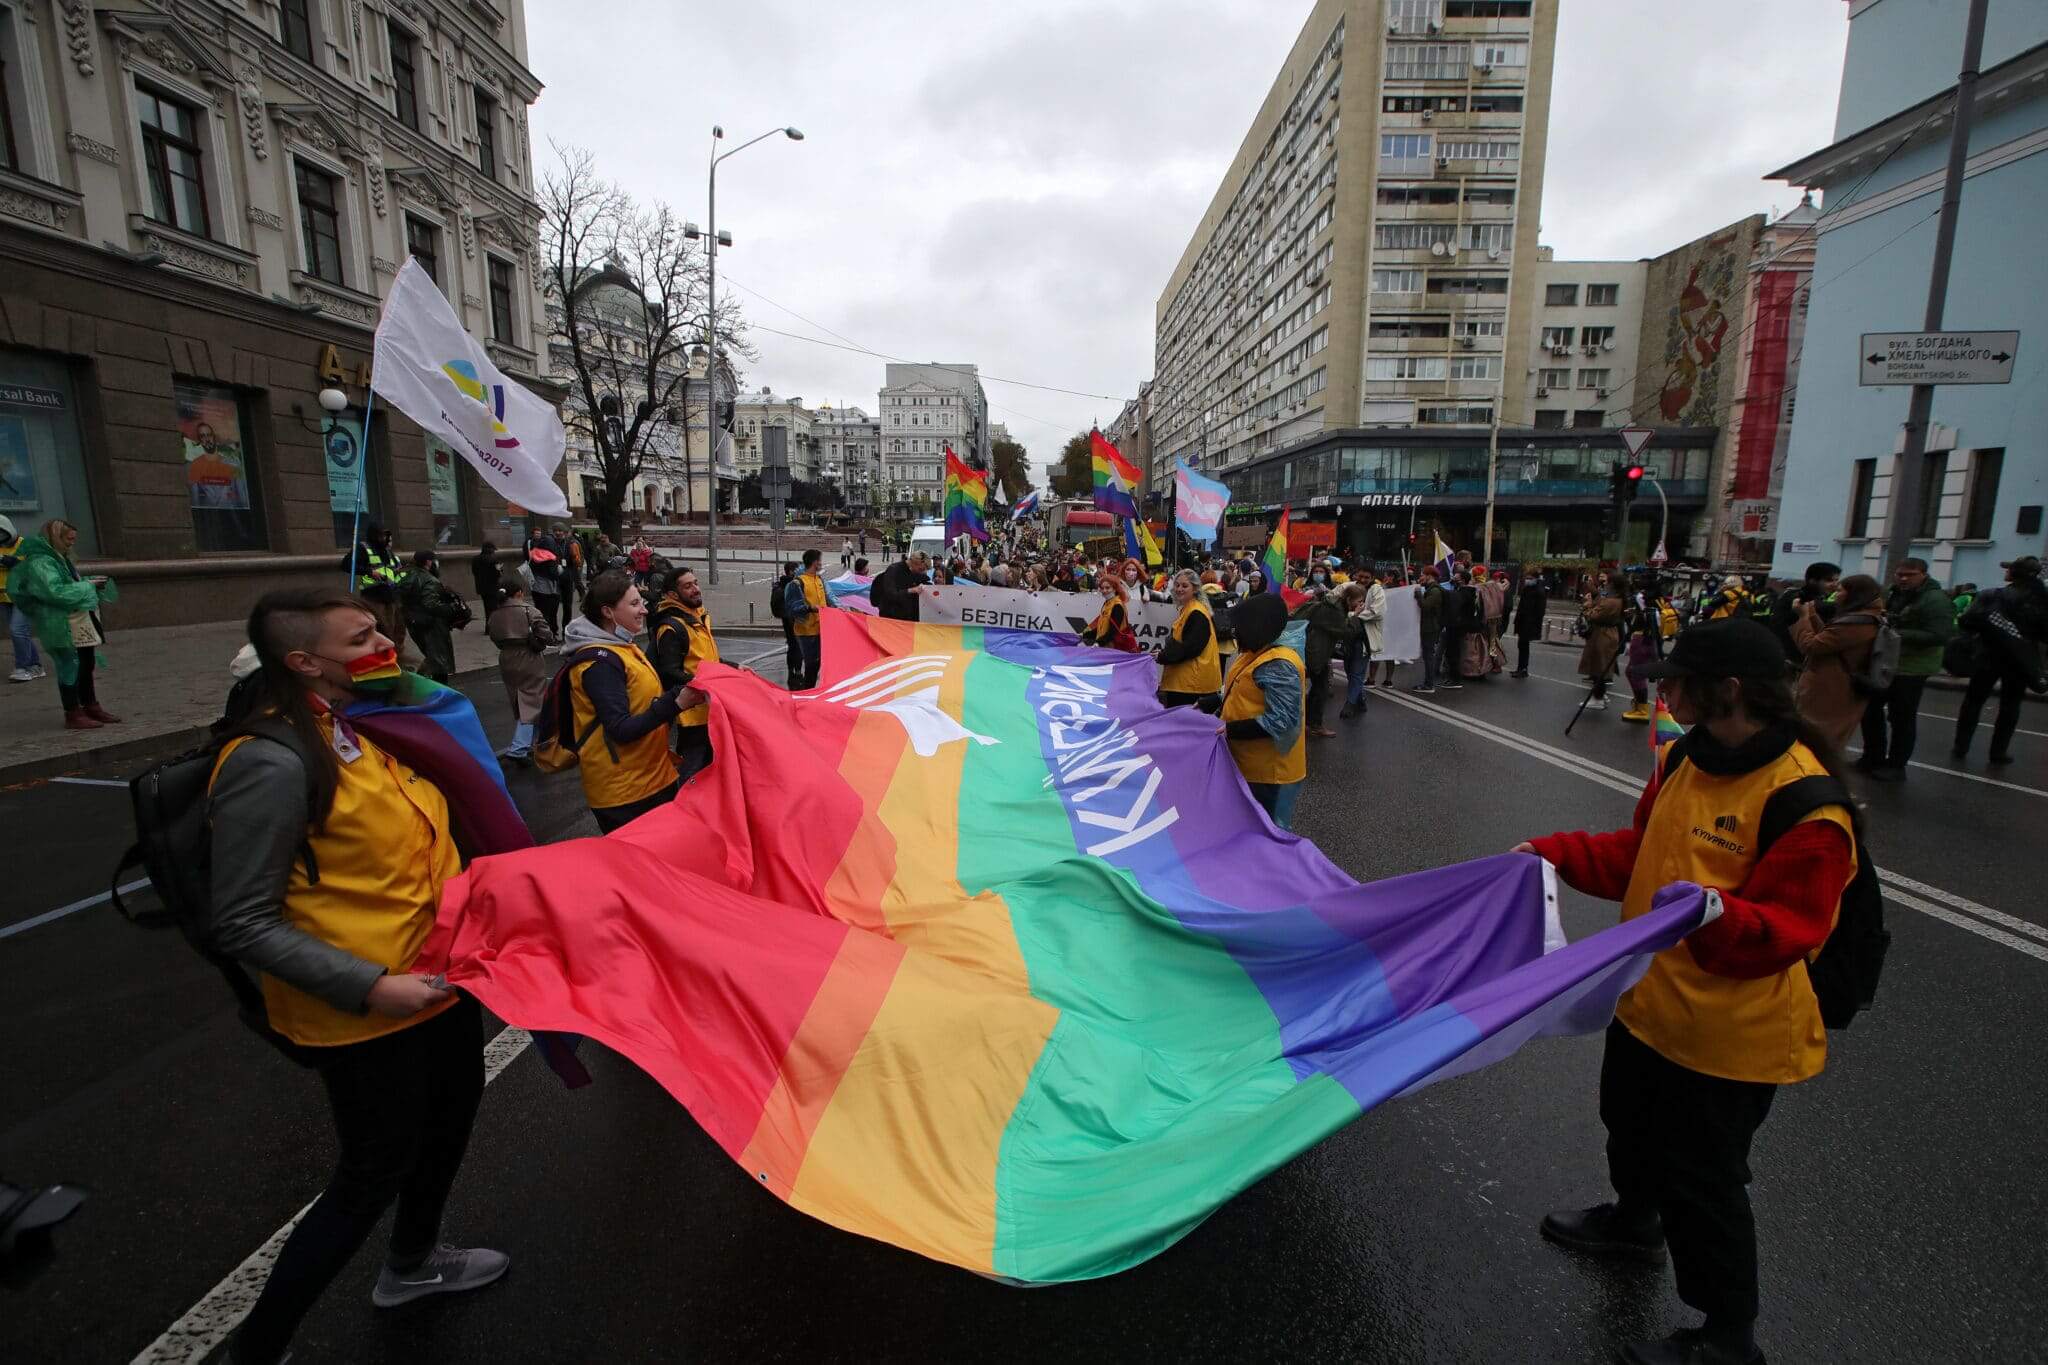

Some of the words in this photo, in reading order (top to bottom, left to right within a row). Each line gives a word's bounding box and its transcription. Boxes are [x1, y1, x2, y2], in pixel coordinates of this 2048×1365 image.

[1888, 341, 1911, 350] вул.
[1916, 337, 1972, 348] БОГДАНА
[1888, 349, 1991, 361] ХМЕЛЬНИЦЬКОГО
[25, 390, 60, 405] Bank
[1361, 494, 1422, 506] АПТЕКА
[961, 607, 1053, 631] БЕЗПЕКА
[1691, 826, 1745, 855] KYIVPRIDE
